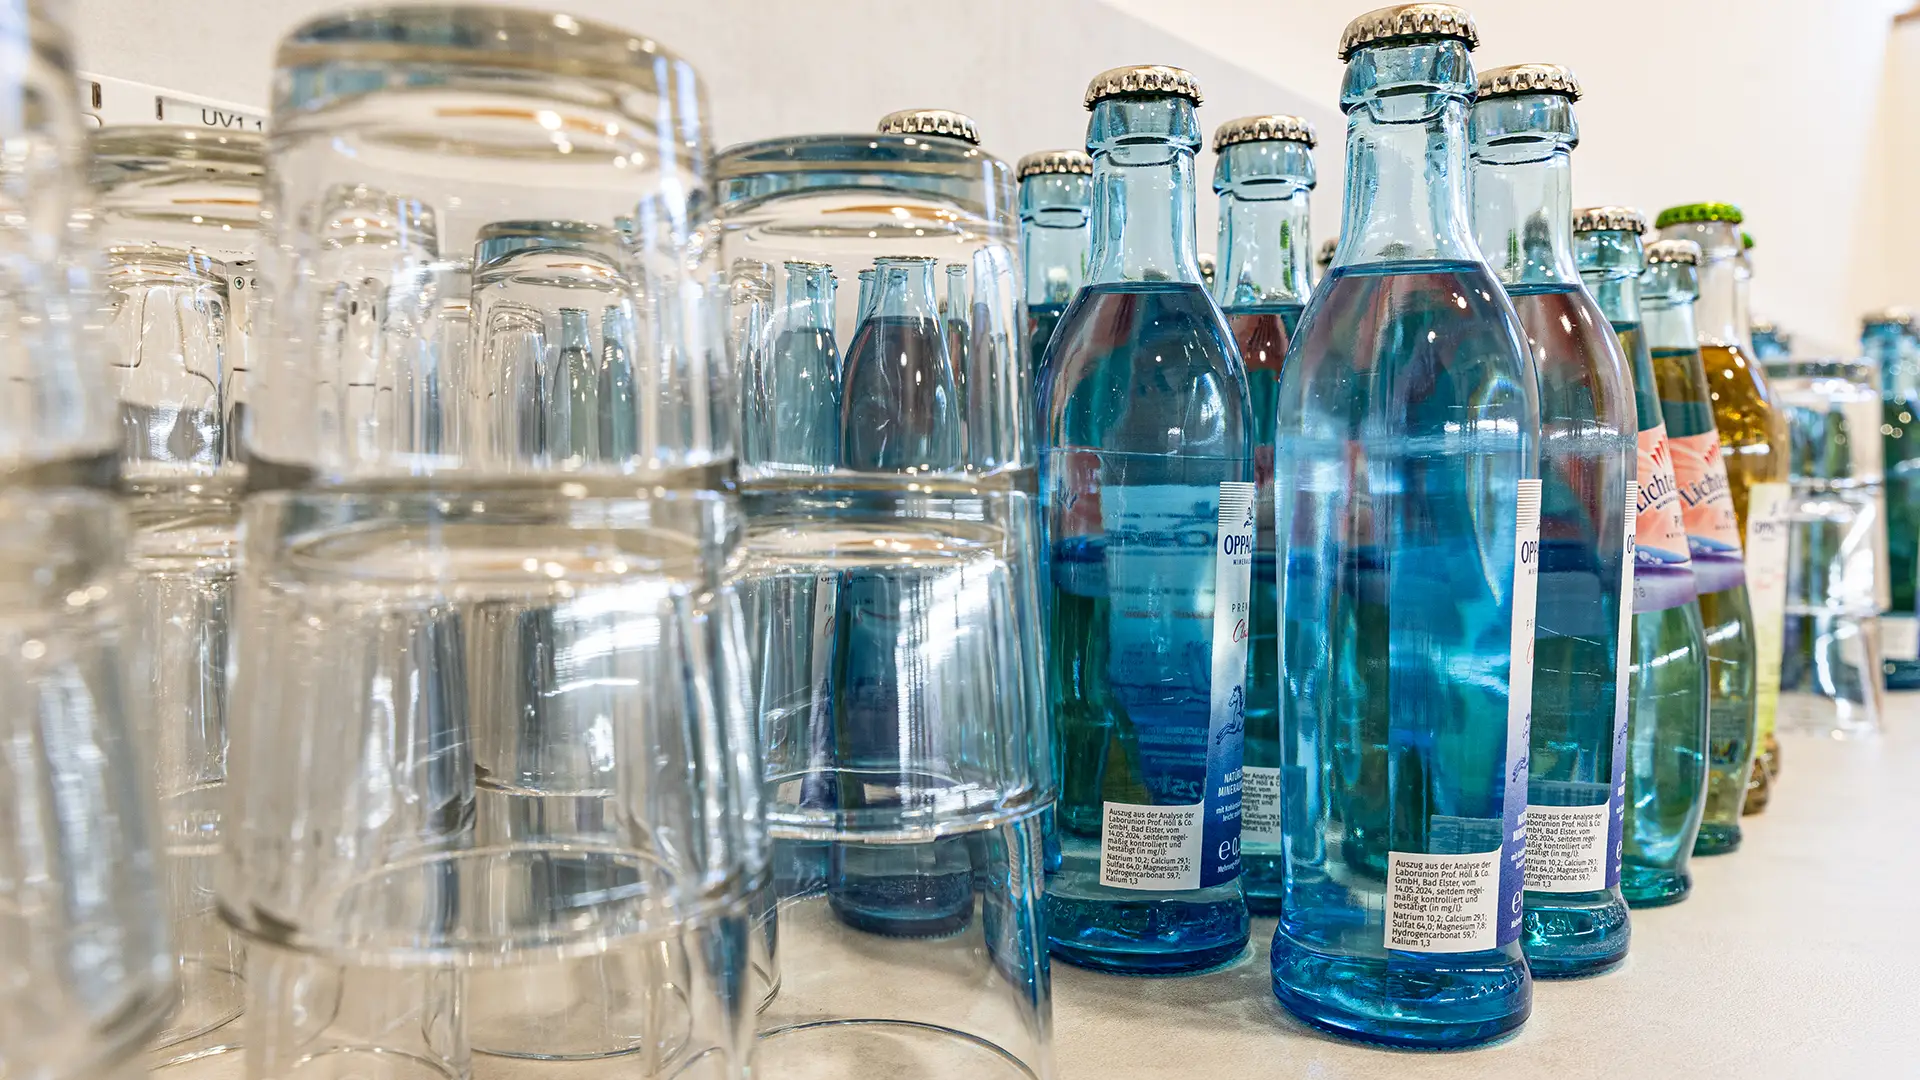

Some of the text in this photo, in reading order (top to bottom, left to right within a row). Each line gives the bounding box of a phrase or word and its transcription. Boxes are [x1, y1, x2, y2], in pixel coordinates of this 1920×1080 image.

[1109, 809, 1131, 818] Auszug
[1109, 816, 1145, 825] Laborunion
[1109, 823, 1130, 831] GmbH,
[1108, 838, 1128, 847] mäßig
[1108, 845, 1135, 854] bestätigt
[1525, 849, 1549, 857] estätigt
[1107, 853, 1132, 862] Natrium
[1396, 860, 1423, 870] Auszug
[1454, 863, 1479, 871] Analyse
[1106, 868, 1165, 878] Hydrogencarbonat
[1396, 868, 1439, 877] Laborunion
[1106, 875, 1127, 883] Kalium
[1395, 876, 1420, 885] GmbH,
[1467, 887, 1484, 896] regel-
[1394, 894, 1418, 904] mäßig
[1394, 901, 1462, 913] bestätigt (in mg/l):
[1393, 912, 1424, 920] Natrium
[1393, 920, 1415, 929] Sulfat
[1417, 922, 1434, 930] 64,0;
[1436, 923, 1475, 932] Magnesium
[1392, 929, 1460, 938] Hydrogencarbonat
[1392, 937, 1418, 946] Kalium
